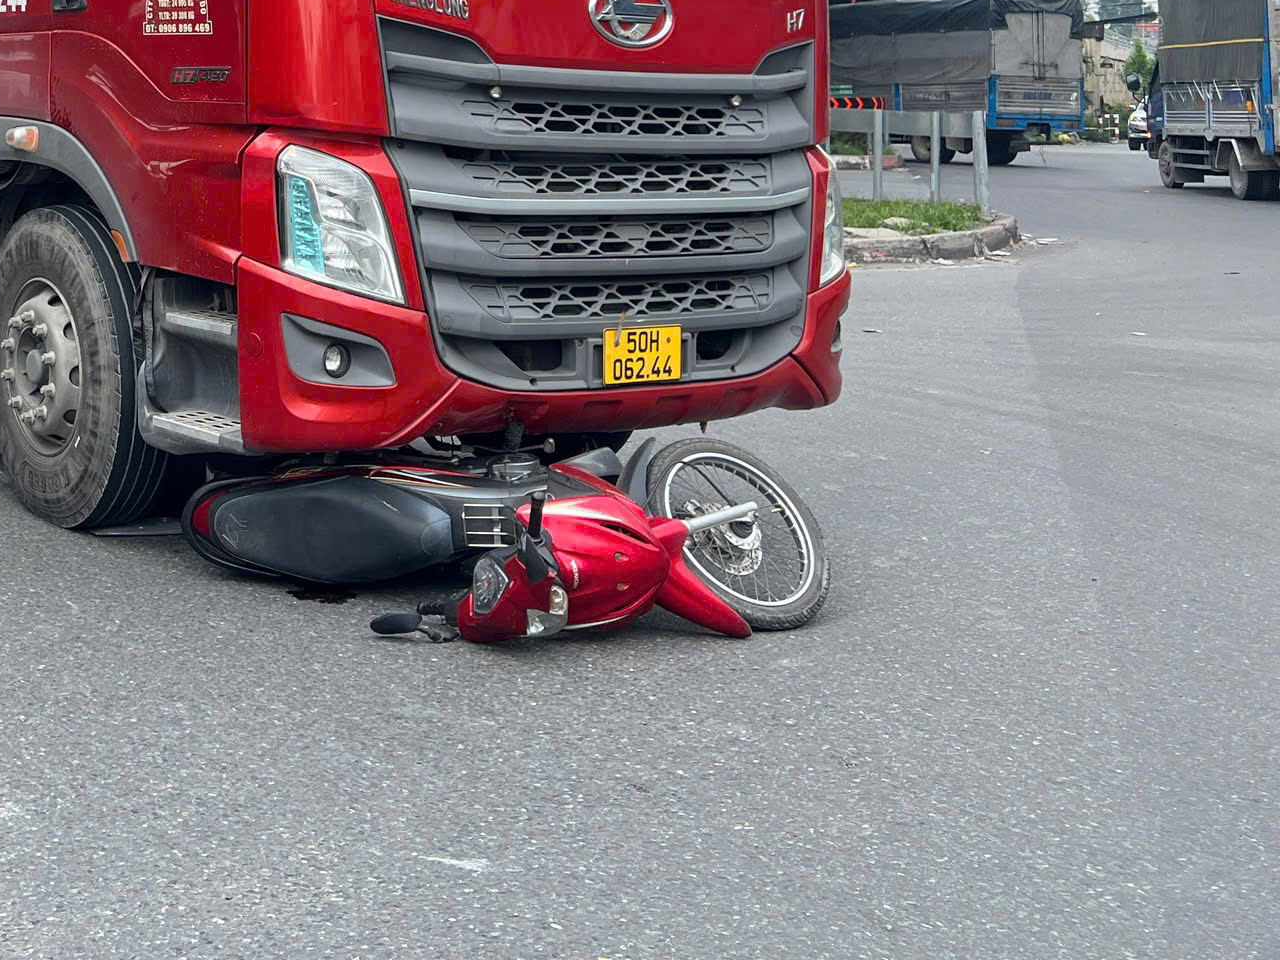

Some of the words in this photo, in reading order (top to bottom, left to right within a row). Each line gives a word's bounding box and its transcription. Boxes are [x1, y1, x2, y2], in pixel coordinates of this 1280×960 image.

[158, 23, 177, 33] 0906
[178, 23, 193, 33] 896
[194, 23, 210, 33] 469
[786, 8, 805, 33] H7
[173, 69, 195, 82] H7
[626, 330, 660, 354] 50H
[612, 355, 673, 381] 062.44
